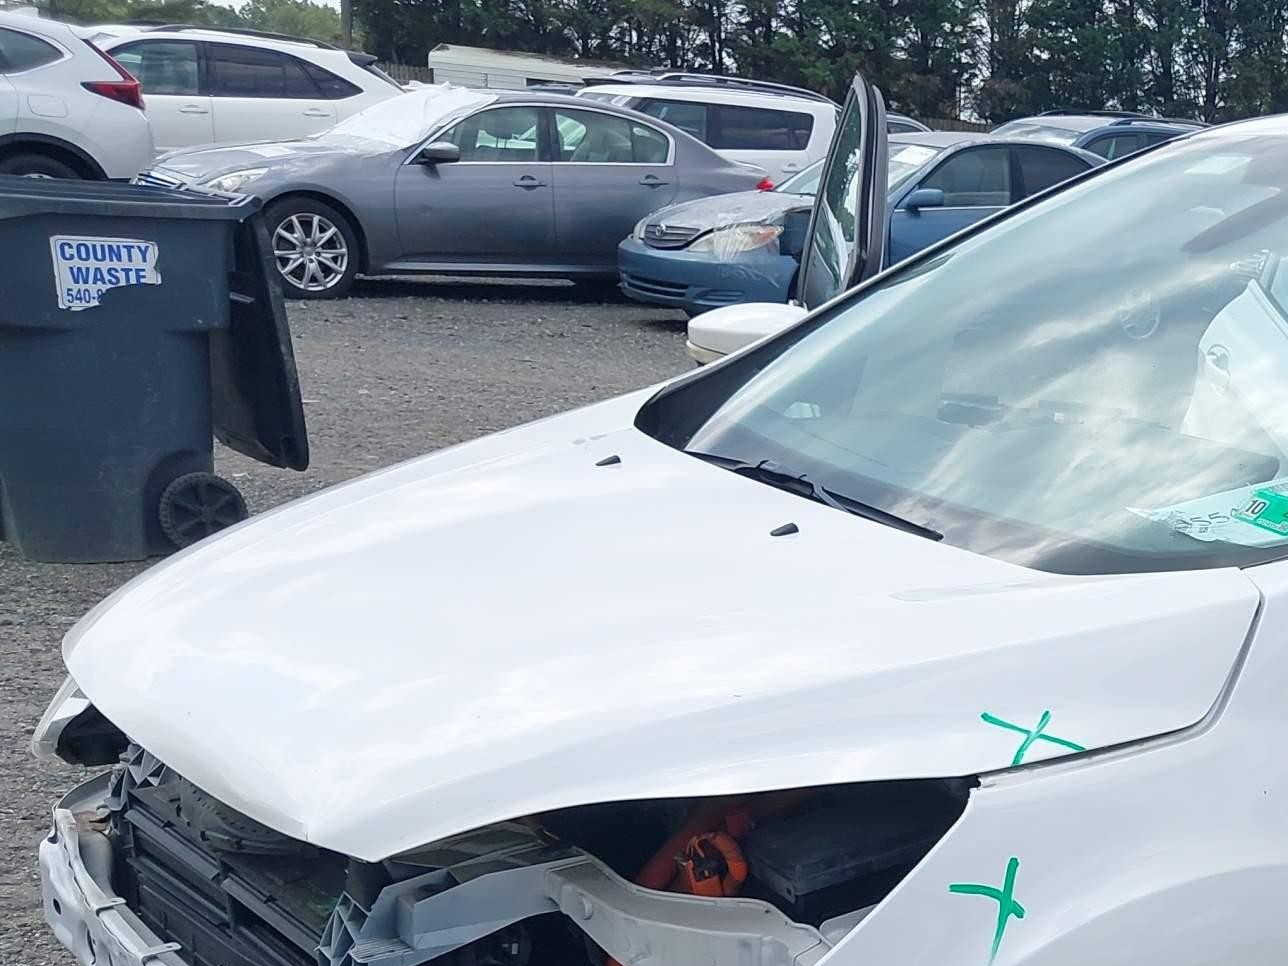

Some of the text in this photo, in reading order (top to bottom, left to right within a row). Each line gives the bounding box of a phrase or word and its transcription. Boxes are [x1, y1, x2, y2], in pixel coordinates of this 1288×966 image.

[59, 242, 150, 263] COUNTY
[68, 266, 147, 286] WASTE
[1245, 499, 1267, 515] 10
